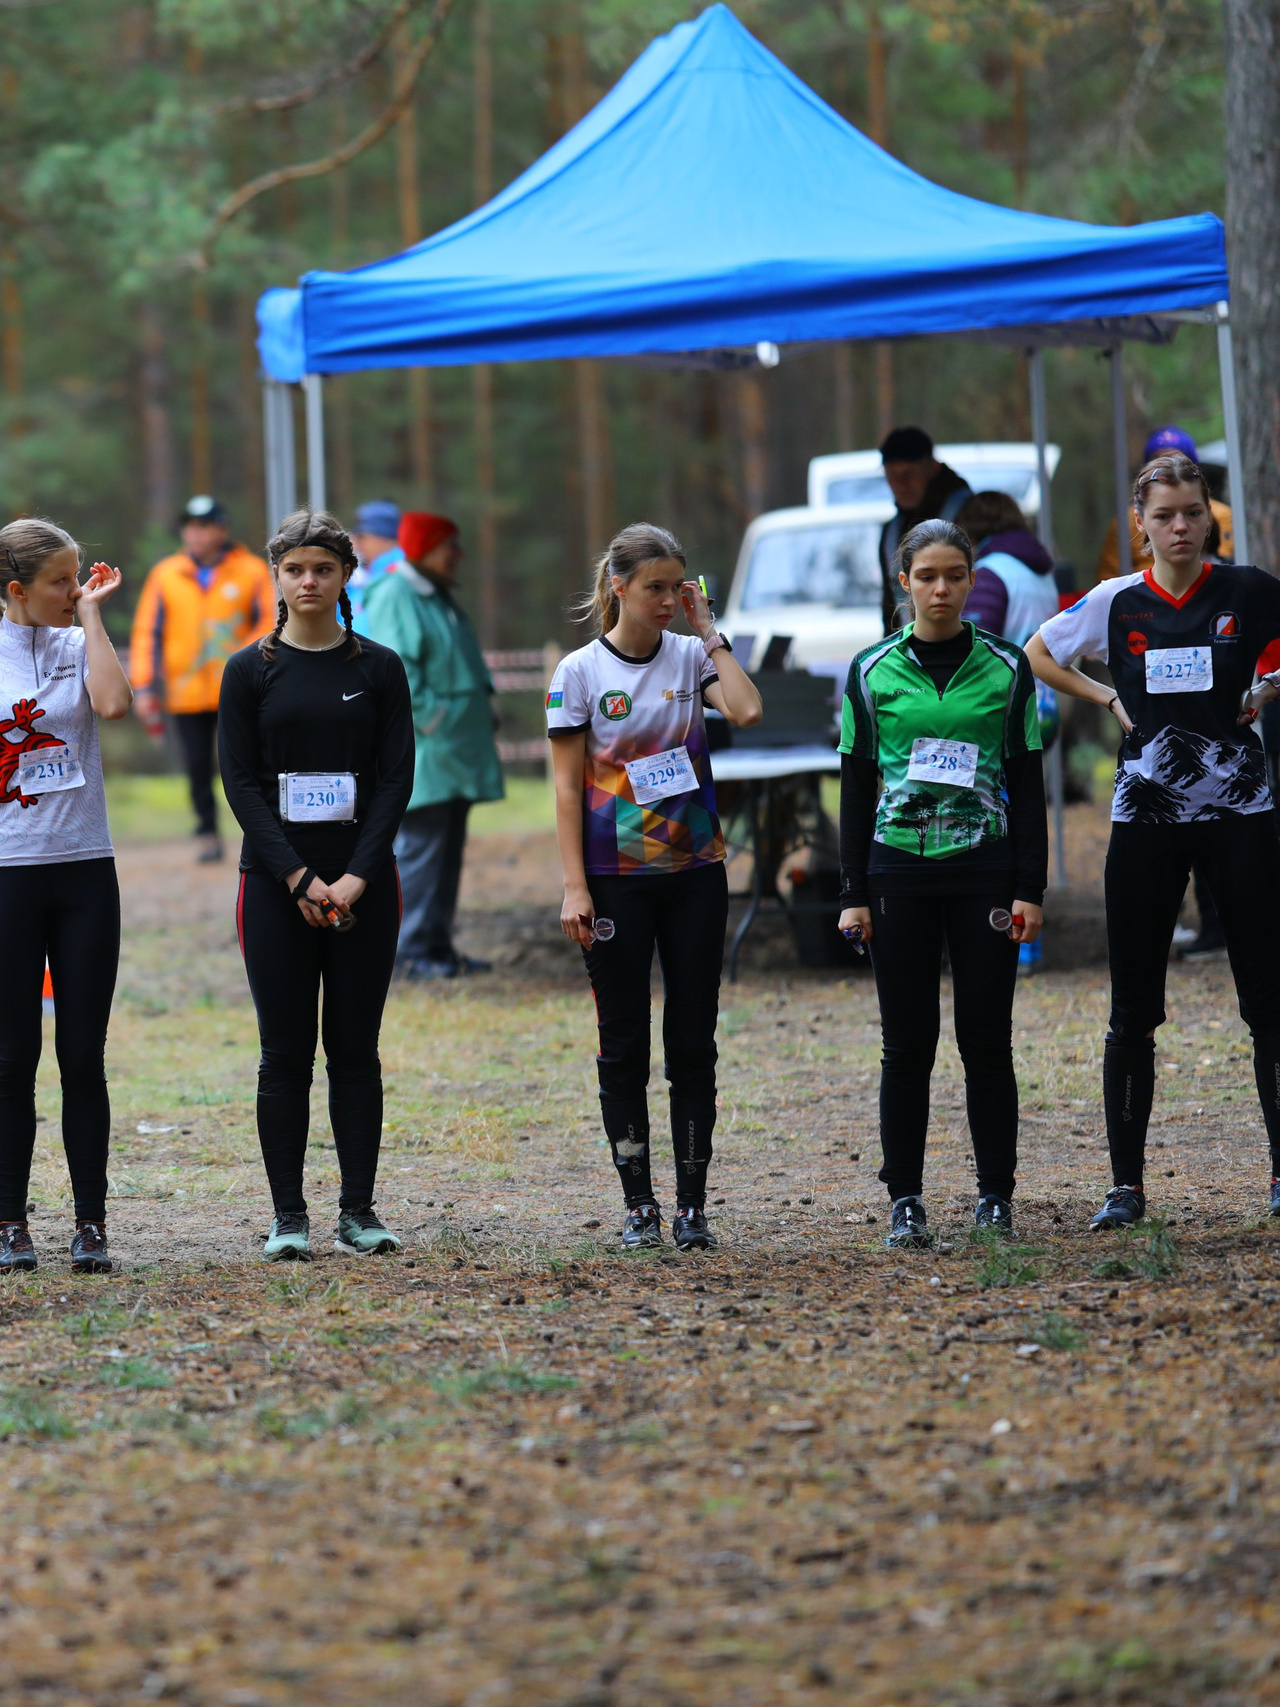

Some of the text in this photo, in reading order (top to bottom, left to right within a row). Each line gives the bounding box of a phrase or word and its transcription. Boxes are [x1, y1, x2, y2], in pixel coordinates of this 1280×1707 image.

[1165, 664, 1192, 678] 227
[37, 762, 63, 778] 231
[929, 754, 957, 771] 228
[648, 767, 675, 786] 229
[306, 792, 335, 806] 230
